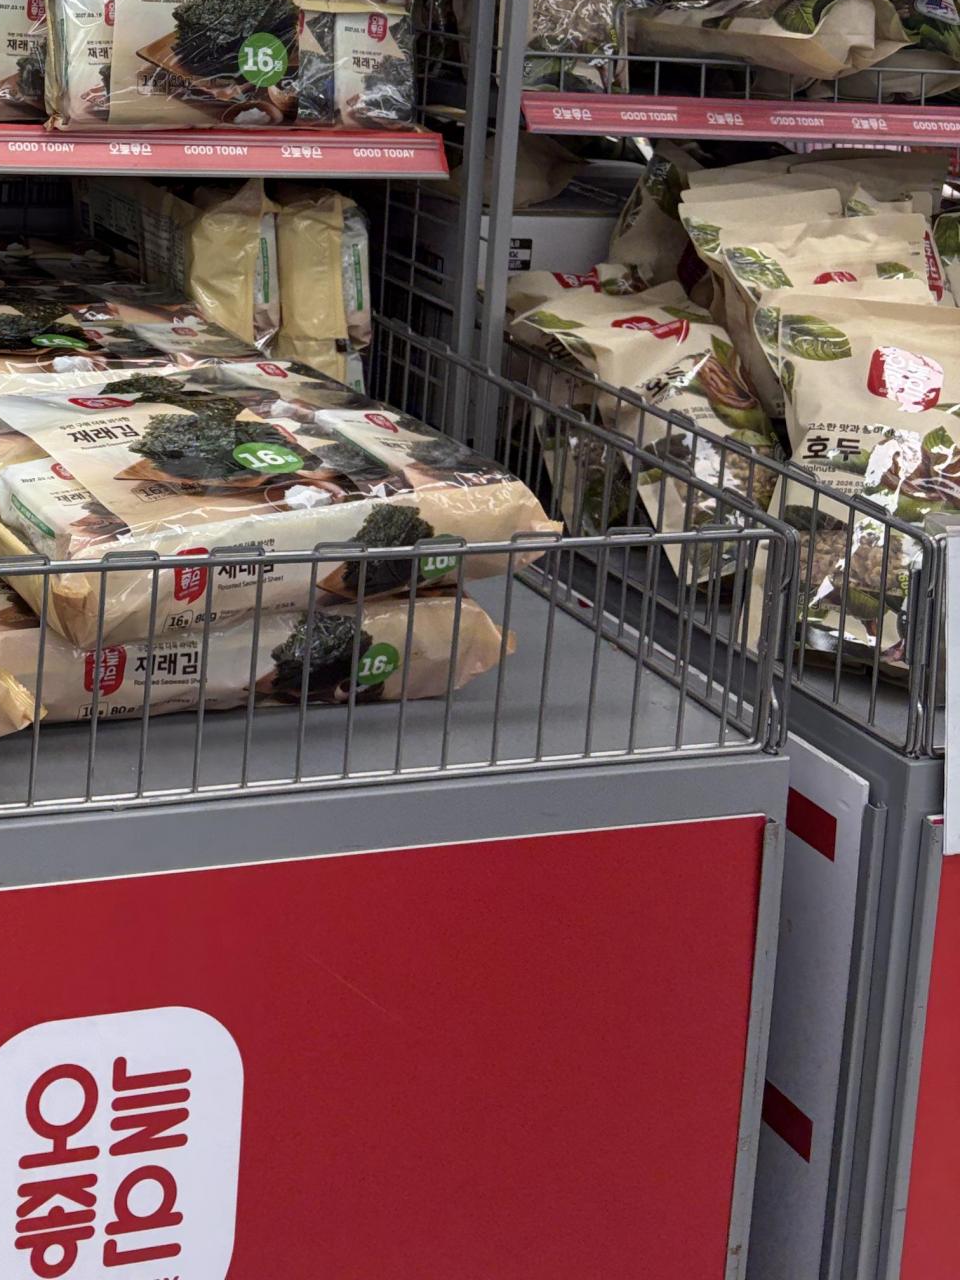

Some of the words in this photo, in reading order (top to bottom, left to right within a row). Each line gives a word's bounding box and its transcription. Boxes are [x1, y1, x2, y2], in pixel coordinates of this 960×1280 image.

[243, 46, 282, 72] 16봉
[352, 56, 380, 70] 재래김
[620, 110, 647, 120] GOOD
[649, 111, 677, 122] TODAY
[769, 115, 794, 125] GOOD
[796, 116, 824, 127] TODAY
[913, 120, 938, 130] GOOD
[8, 142, 38, 152] GOOD
[41, 143, 75, 153] TODAY
[184, 145, 213, 155] GOOD
[215, 146, 248, 156] TODAY
[353, 148, 381, 158] GOOD
[384, 148, 415, 159] TODAY
[67, 423, 140, 444] 재래김
[808, 422, 837, 432] 고소한
[839, 424, 861, 434] 맛과
[802, 435, 861, 462] 호두
[218, 581, 242, 591] Roasted
[267, 575, 284, 583] Sheet
[161, 677, 188, 686] Seaweed
[18, 1056, 192, 1170] 오늘
[14, 1164, 184, 1279] 좋은
